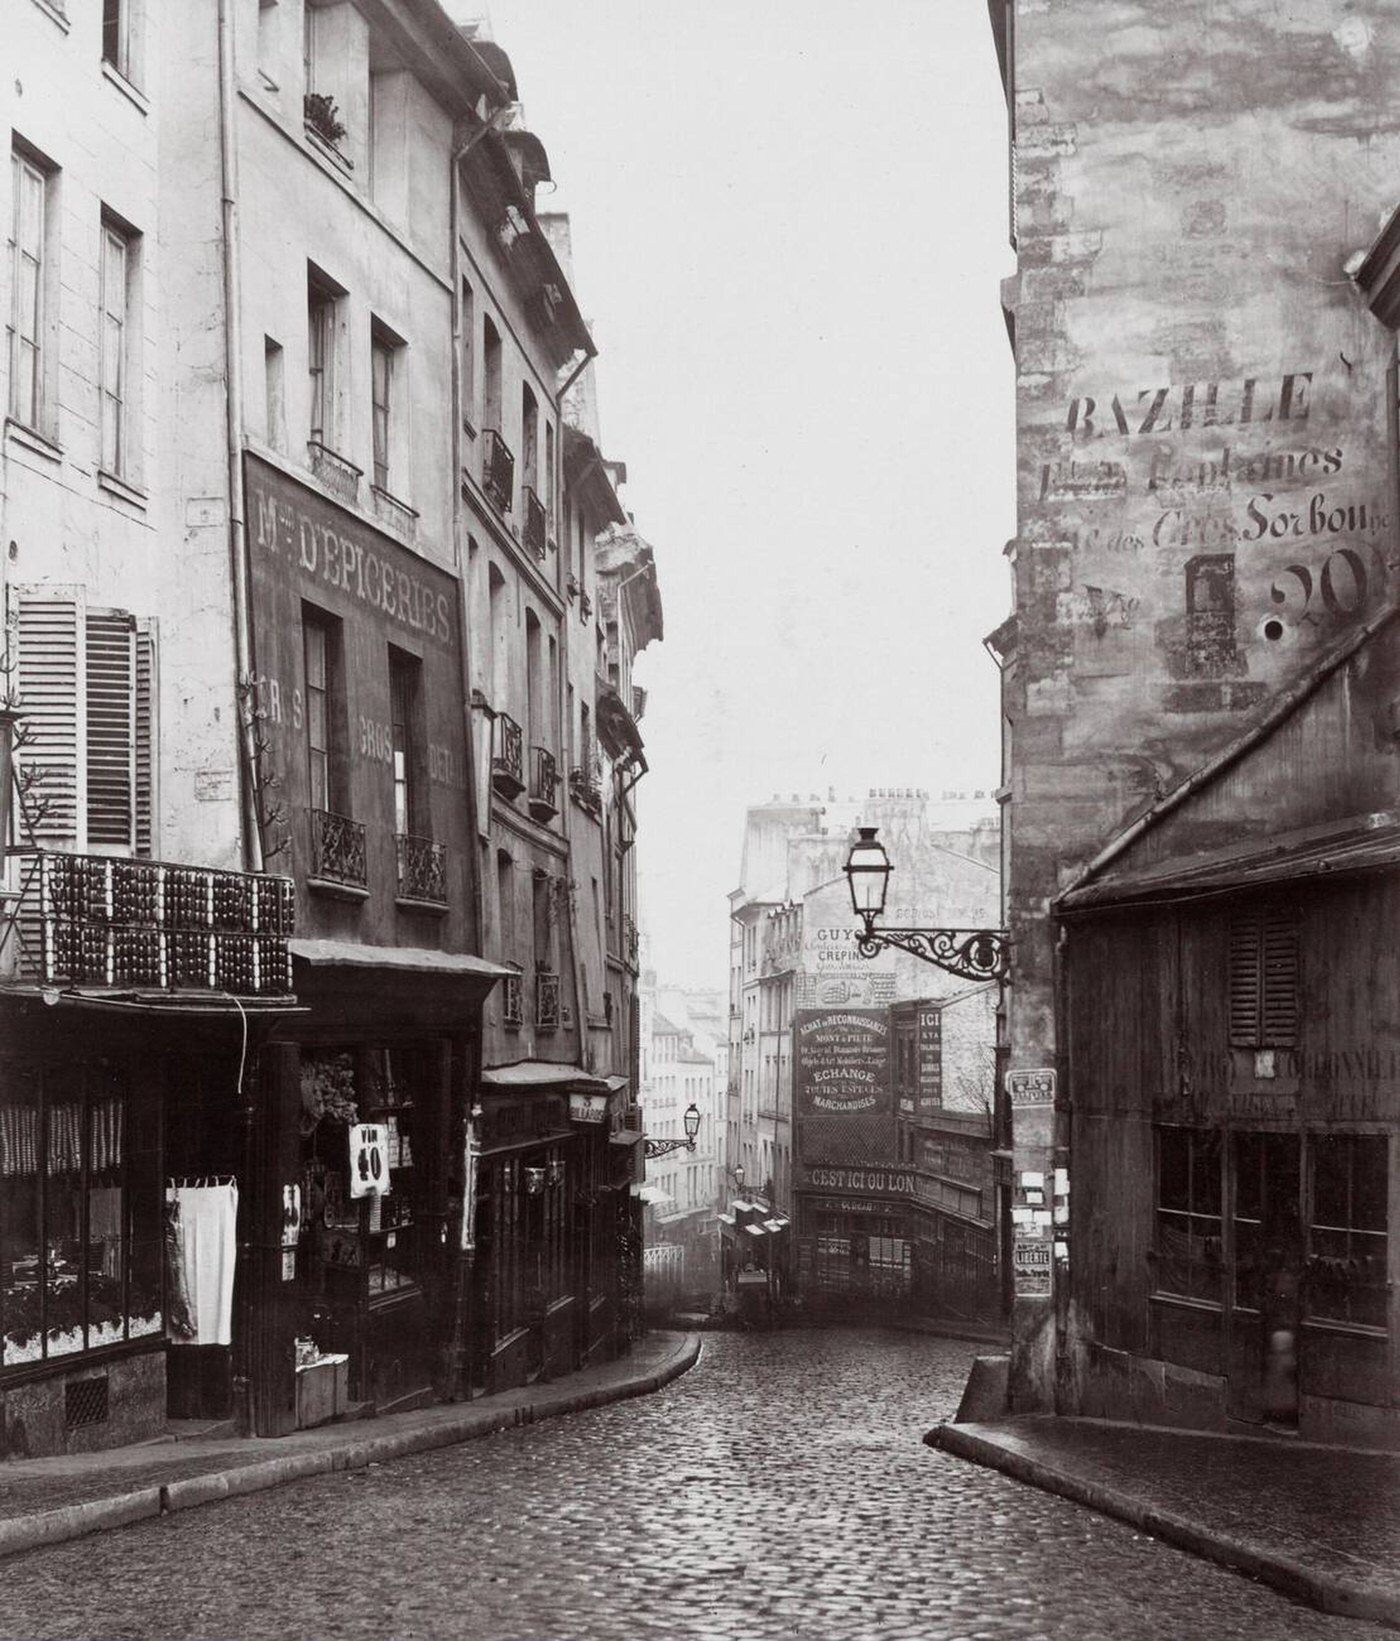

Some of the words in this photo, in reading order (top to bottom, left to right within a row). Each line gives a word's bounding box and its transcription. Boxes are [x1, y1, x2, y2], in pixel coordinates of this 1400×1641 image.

[920, 1013, 939, 1026] ICI
[813, 1067, 876, 1083] ECHANGE
[812, 1095, 876, 1111] MARCHANDISES
[361, 1128, 378, 1143] VIN
[357, 1146, 382, 1181] 40
[847, 1170, 864, 1189] ICI
[867, 1171, 884, 1190] OU
